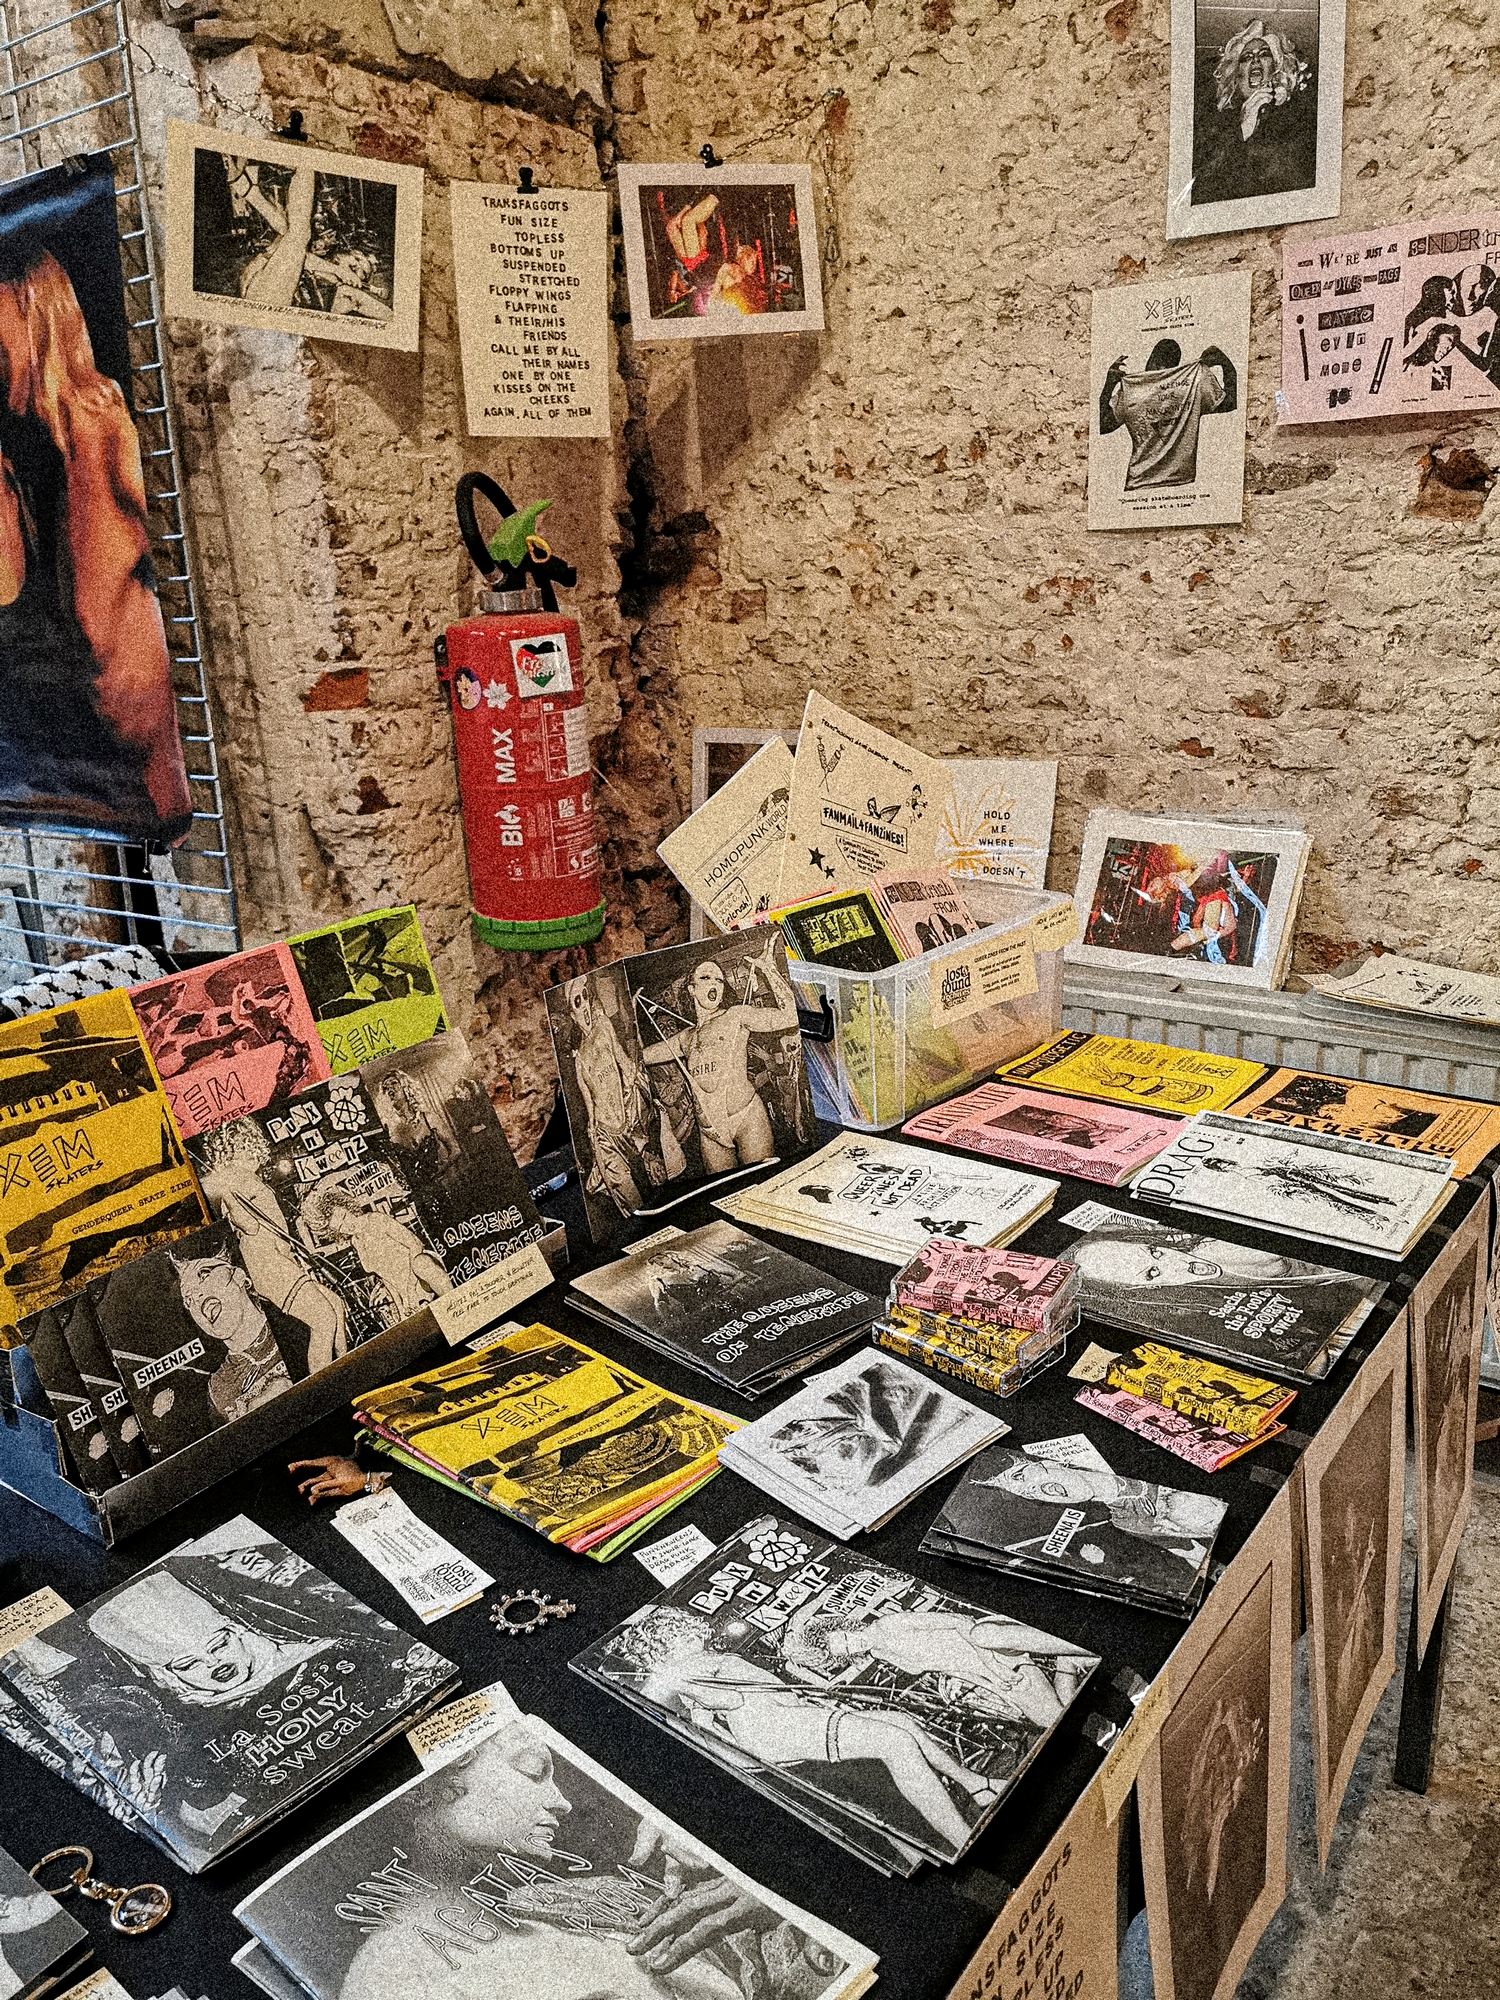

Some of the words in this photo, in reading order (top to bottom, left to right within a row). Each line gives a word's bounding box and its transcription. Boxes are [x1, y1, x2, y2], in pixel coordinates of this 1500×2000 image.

[482, 197, 569, 211] TRANSFAGGOTS
[501, 214, 522, 226] FUN
[531, 217, 558, 228] SIZE
[515, 231, 565, 244] TOPLESS
[490, 243, 542, 257] BOTTOMS
[550, 250, 564, 260] UP
[503, 259, 566, 272] SUSPENDED
[489, 284, 529, 297] FLOPPY
[535, 290, 571, 301] WINGS
[519, 274, 580, 287] STRETCHED
[505, 301, 558, 314] FLAPPING
[1144, 296, 1191, 320] XEM
[508, 316, 566, 328] THEIR/HIS
[523, 330, 567, 341] FRIENDS
[491, 343, 519, 356] CALL
[524, 345, 539, 355] ME
[546, 346, 558, 355] BY
[562, 347, 581, 358] ALL
[502, 370, 524, 380] ONE
[533, 371, 545, 381] BY
[550, 371, 571, 380] ONE
[522, 358, 552, 369] THEIR
[557, 360, 590, 370] NAMES
[493, 384, 532, 394] KISSES
[538, 383, 551, 392] ON
[557, 383, 576, 392] THE
[530, 395, 570, 405] CHEEKS
[523, 409, 543, 420] ALL
[549, 409, 560, 418] OF
[567, 407, 592, 418] THEM
[492, 728, 516, 783] MAX
[984, 811, 1010, 820] HOLD
[991, 825, 1007, 834] ME
[704, 822, 769, 887] HOMOPUNK
[979, 838, 1014, 847] WHERE
[992, 853, 1001, 861] IT
[983, 866, 1026, 879] DOESN'T
[933, 900, 958, 914] FROM
[941, 975, 971, 995] found
[322, 1018, 391, 1068] XEM
[45, 1160, 105, 1194] SKATERS
[347, 1161, 380, 1190] SUMMER
[1138, 1136, 1215, 1198] DRAG
[366, 1183, 375, 1196] OF
[375, 1172, 394, 1189] LOVE
[843, 1175, 883, 1199] QUEER
[871, 1175, 899, 1196] ZINES
[882, 1192, 903, 1205] NOT
[898, 1169, 923, 1191] DEAD
[71, 1202, 134, 1236] GENDERQUEER
[138, 1188, 167, 1208] SKATE
[170, 1178, 194, 1194] ZINE
[443, 1205, 524, 1248] QUEENS
[702, 1319, 749, 1345] THE
[742, 1287, 837, 1323] QUEENS
[1209, 1291, 1248, 1319] Sascha
[1243, 1293, 1293, 1339] SPORTY
[1224, 1314, 1248, 1332] the
[1270, 1306, 1304, 1335] sweat
[137, 1351, 188, 1385] SHEENA
[189, 1342, 203, 1357] IS
[1125, 1377, 1143, 1388] SONGS
[1145, 1383, 1161, 1393] FROM
[1163, 1390, 1177, 1400] THE
[1179, 1394, 1202, 1408] XEROX
[461, 1394, 558, 1439] XEM
[521, 1405, 570, 1430] SKATERS
[1092, 1399, 1110, 1411] SONGS
[1111, 1408, 1127, 1420] FROM
[1128, 1416, 1142, 1428] THE
[1141, 1423, 1164, 1439] XEROX
[1045, 1519, 1076, 1554] SHEENA
[1068, 1510, 1083, 1520] IS
[433, 1562, 472, 1593] found
[826, 1575, 860, 1610] SUMMER
[852, 1595, 867, 1608] OF
[860, 1573, 884, 1598] LOVE
[204, 1730, 256, 1763] La
[256, 1659, 356, 1726] Sosi's
[437, 1700, 465, 1716] AGATA
[468, 1685, 497, 1702] MEETS
[246, 1685, 348, 1767] HOLY
[414, 1720, 445, 1735] KATHY
[418, 1724, 451, 1742] SARAH
[439, 1733, 465, 1749] DYKE
[469, 1721, 494, 1735] BAR
[263, 1702, 374, 1785] sweat
